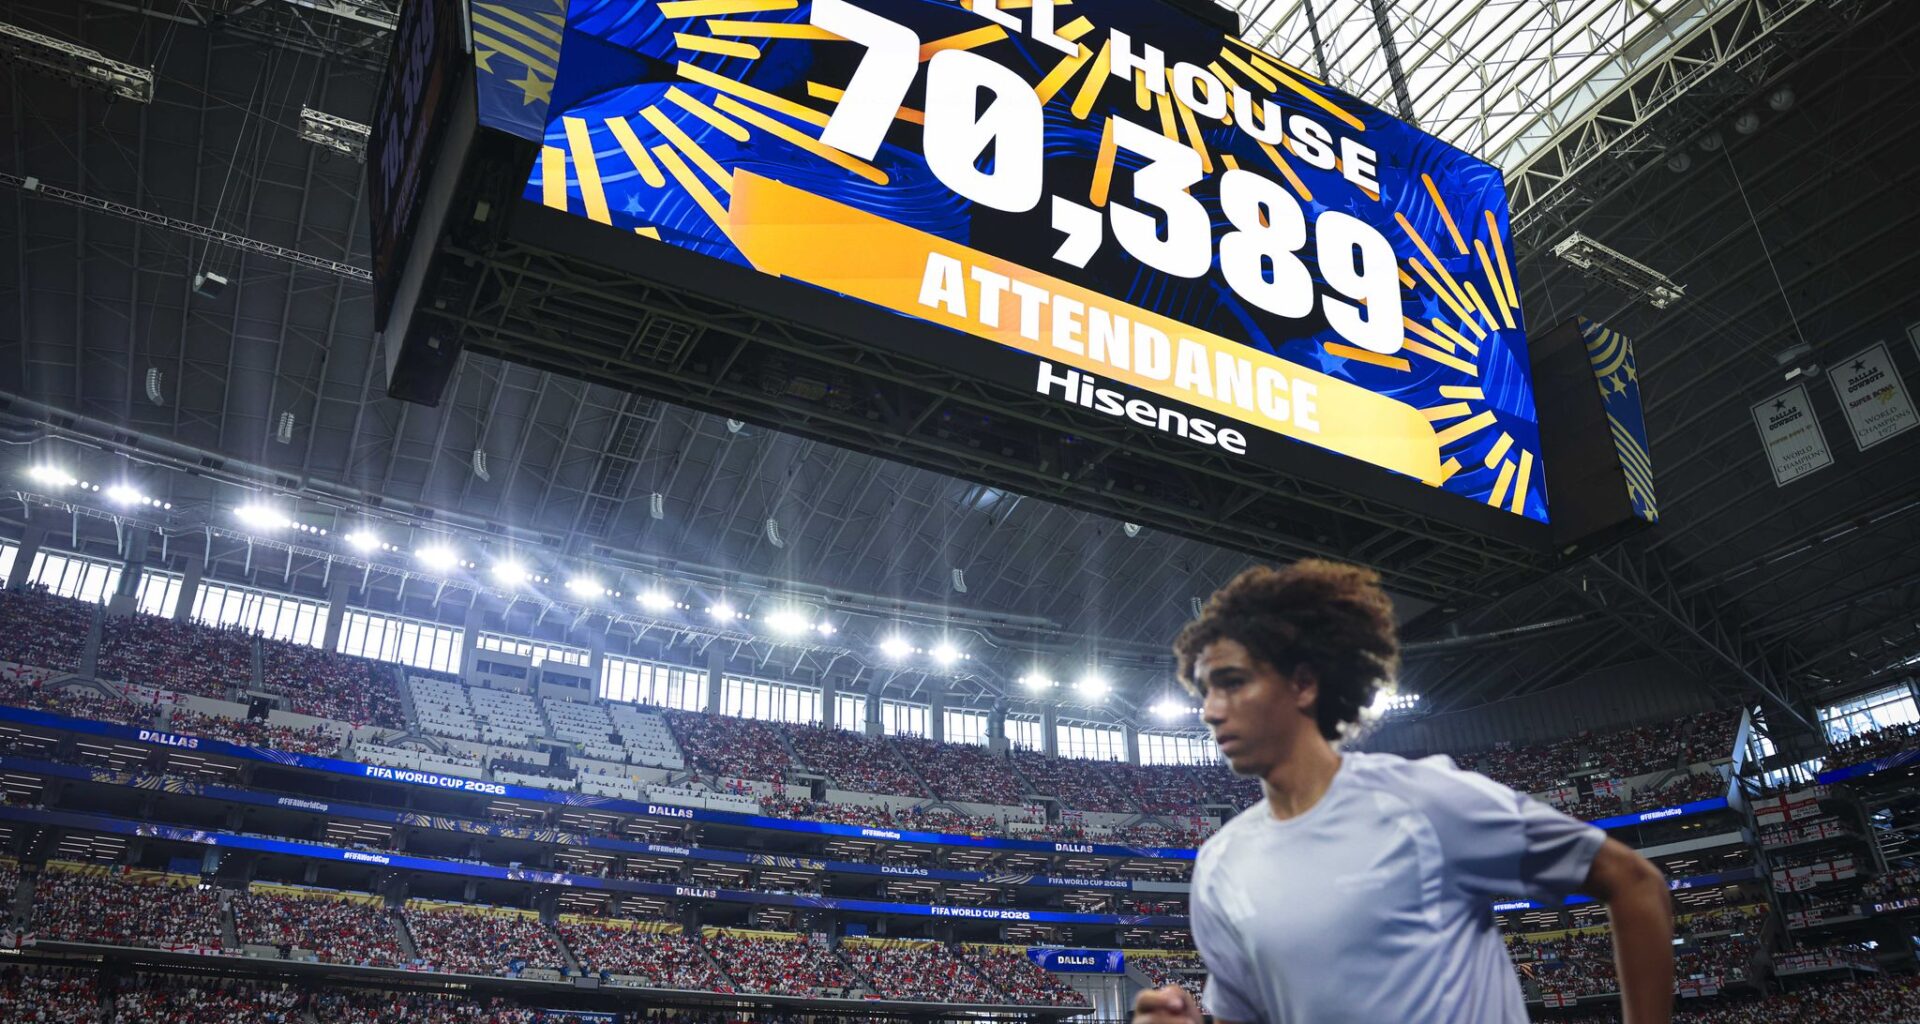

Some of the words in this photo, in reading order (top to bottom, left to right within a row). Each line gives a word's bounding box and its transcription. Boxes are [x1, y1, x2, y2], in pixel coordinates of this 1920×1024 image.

[971, 0, 1079, 59] LL
[1109, 27, 1381, 195] HOUSE
[810, 0, 1405, 355] 70,389
[918, 251, 1321, 434] ATTENDANCE
[1847, 366, 1879, 385] DALLAS
[1847, 371, 1885, 394] COWBOYS
[1036, 361, 1247, 456] Hisense
[1769, 406, 1798, 423] DALLAS
[1864, 406, 1898, 425] WORLD
[1769, 411, 1803, 431] COWBOYS
[1858, 409, 1911, 437] CHAMPIONS
[1777, 450, 1824, 473] CHAMPIONS
[1782, 445, 1813, 462] WORLD
[138, 730, 199, 749] DALLAS
[366, 766, 393, 779] FIFA
[394, 770, 438, 785] WORLD
[439, 777, 463, 789] CUP
[464, 781, 506, 795] 2026
[278, 797, 329, 811] #FIFAWorldCup
[648, 805, 693, 818] DALLAS
[1055, 843, 1094, 853] DALLAS
[881, 866, 928, 876] DALLAS
[1048, 877, 1064, 886] FIFA
[1064, 878, 1089, 886] WORLD
[1089, 879, 1103, 887] CUP
[1104, 880, 1128, 888] 2026
[676, 887, 716, 898] DALLAS
[931, 907, 950, 916] FIFA
[951, 908, 981, 918] WORLD
[982, 910, 1000, 918] CUP
[1000, 911, 1030, 920] 2026
[1874, 898, 1920, 912] DALLAS
[1057, 956, 1095, 965] DALLAS
